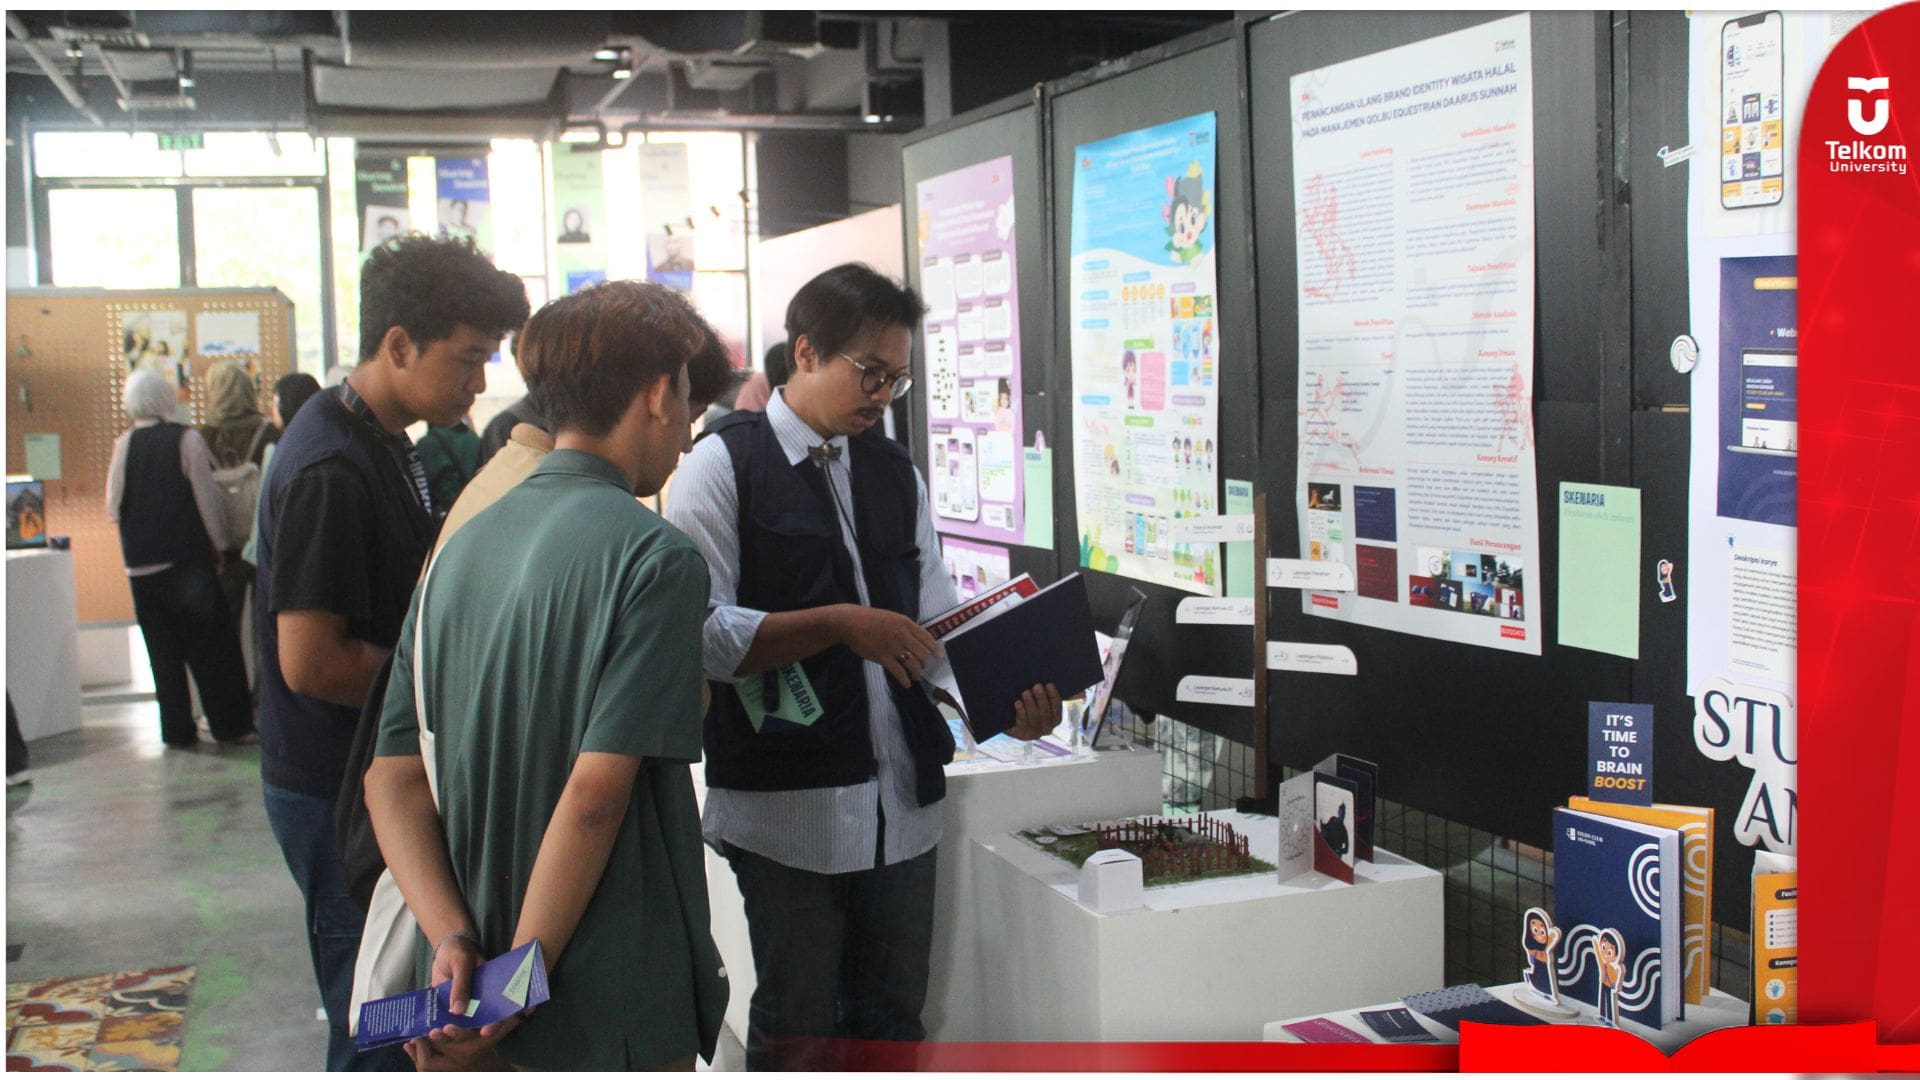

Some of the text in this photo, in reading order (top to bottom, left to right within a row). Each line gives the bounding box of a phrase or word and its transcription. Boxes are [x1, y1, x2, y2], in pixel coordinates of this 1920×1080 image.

[1356, 93, 1383, 108] ULANG
[1384, 86, 1412, 101] BRAND
[1412, 78, 1450, 96] IDENTITY
[1451, 69, 1484, 86] WISATA
[1485, 62, 1517, 78] HALAL
[1479, 82, 1518, 101] SUNNAH
[1564, 490, 1605, 507] SKENARIA
[781, 662, 816, 718] SKENARIA
[1606, 714, 1634, 727] IT'S
[1602, 729, 1638, 743] TIME
[1609, 745, 1630, 758] TO
[1596, 760, 1643, 775] BRAIN
[1594, 775, 1647, 790] BOOST
